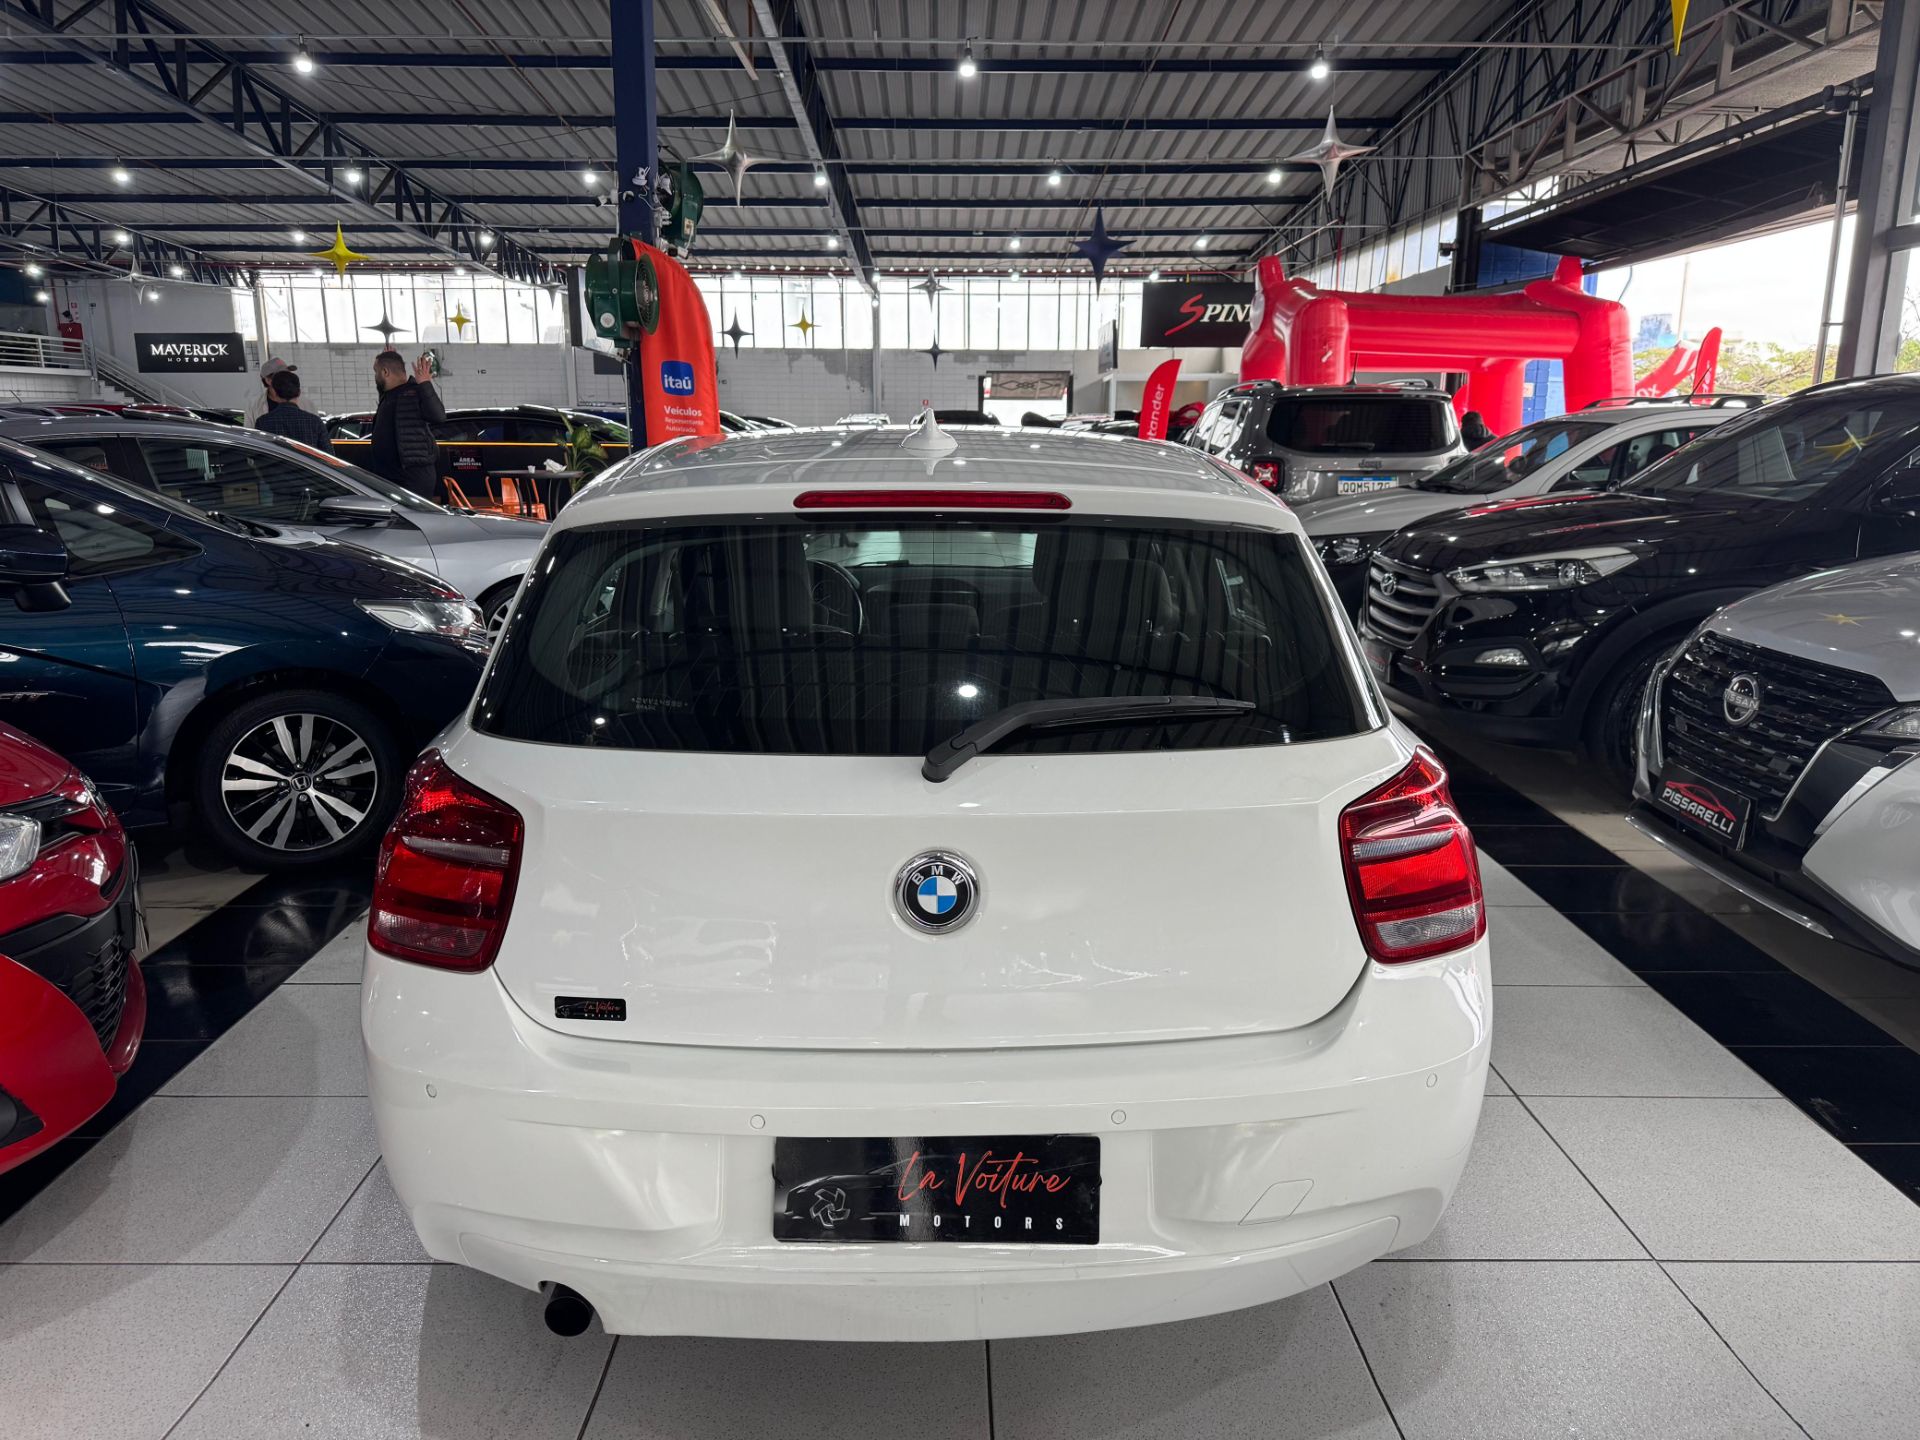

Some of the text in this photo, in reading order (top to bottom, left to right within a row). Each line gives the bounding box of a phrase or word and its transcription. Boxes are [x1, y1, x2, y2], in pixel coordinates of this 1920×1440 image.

[1164, 293, 1252, 336] SPIN
[150, 343, 229, 356] MAVERICK
[664, 374, 692, 390] itaú
[1662, 788, 1734, 833] PISSARELLI
[912, 866, 964, 885] BMW
[898, 1151, 1071, 1208] La Voiture
[899, 1214, 1063, 1230] MOTORS
